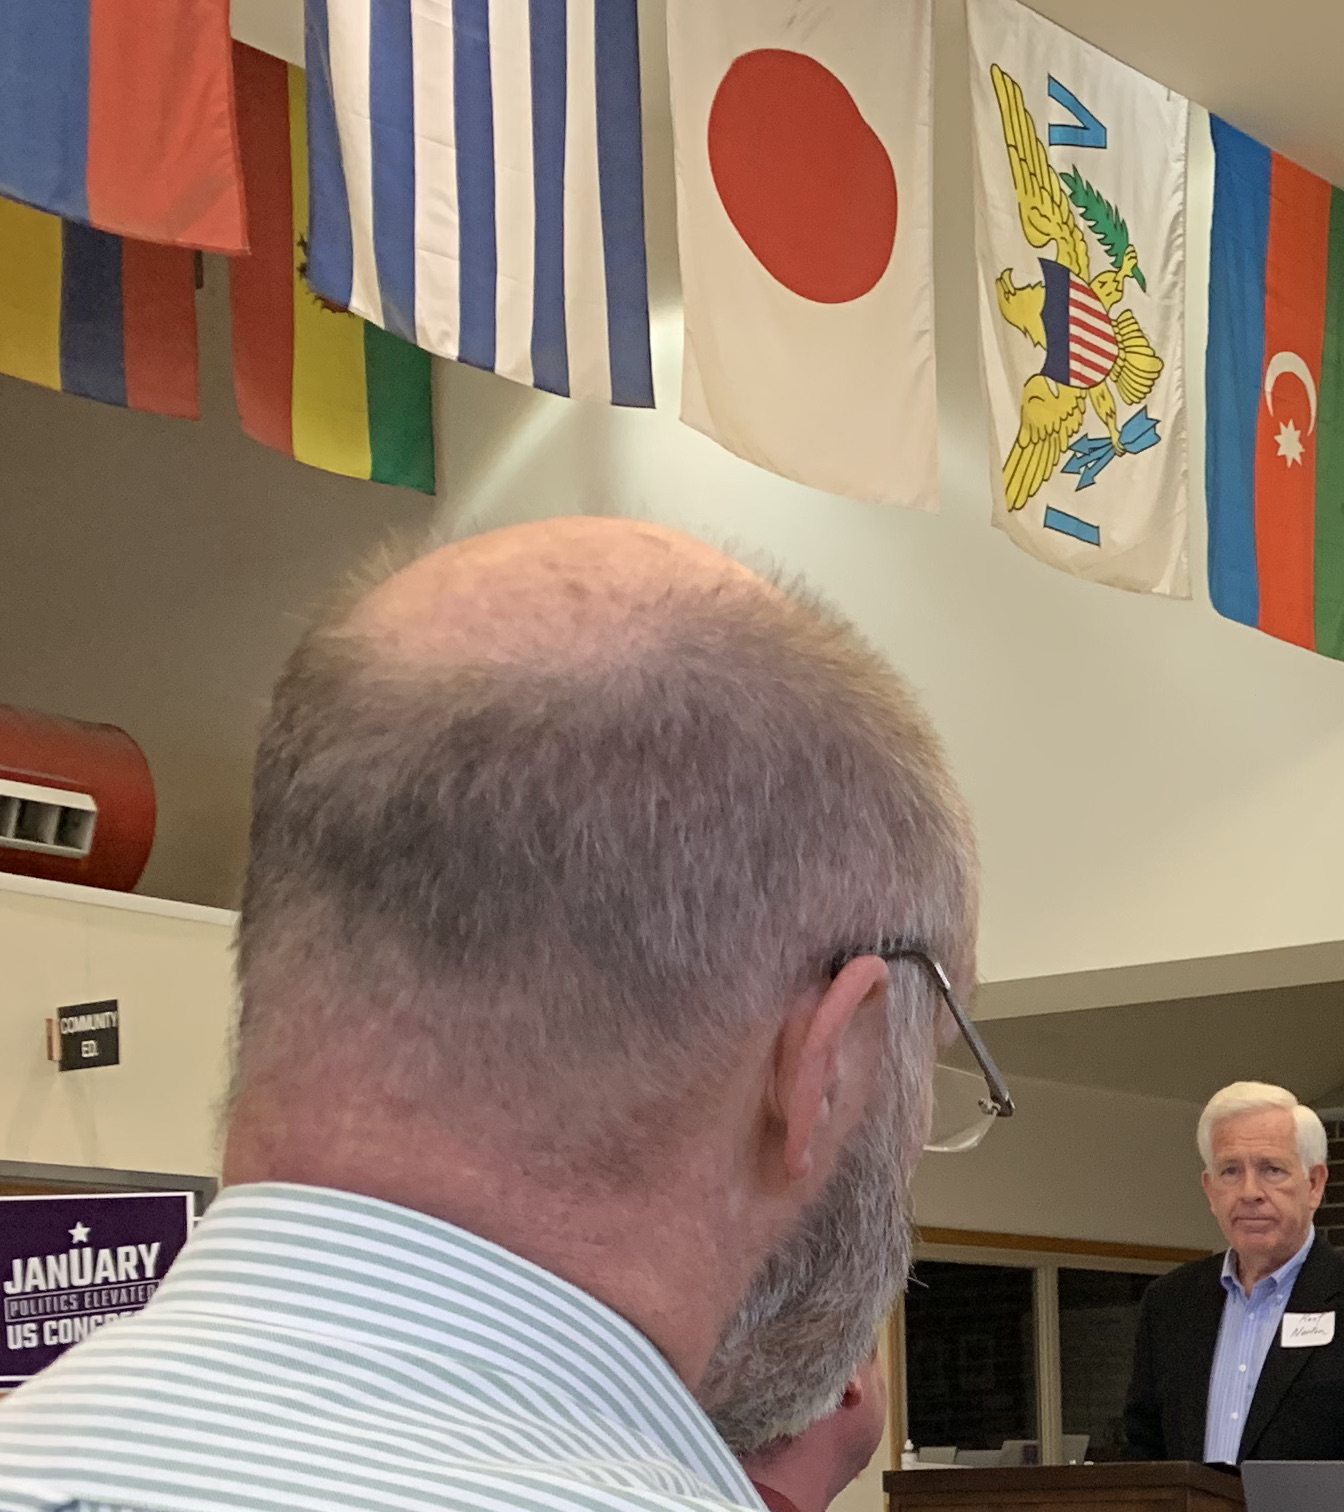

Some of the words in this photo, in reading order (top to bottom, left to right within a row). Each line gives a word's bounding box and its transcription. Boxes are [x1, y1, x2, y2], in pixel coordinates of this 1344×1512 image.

[61, 1011, 118, 1035] COMMUNITY
[3, 1242, 161, 1295] JANUARY
[10, 1294, 79, 1317] POLITICS
[7, 1323, 38, 1350] US
